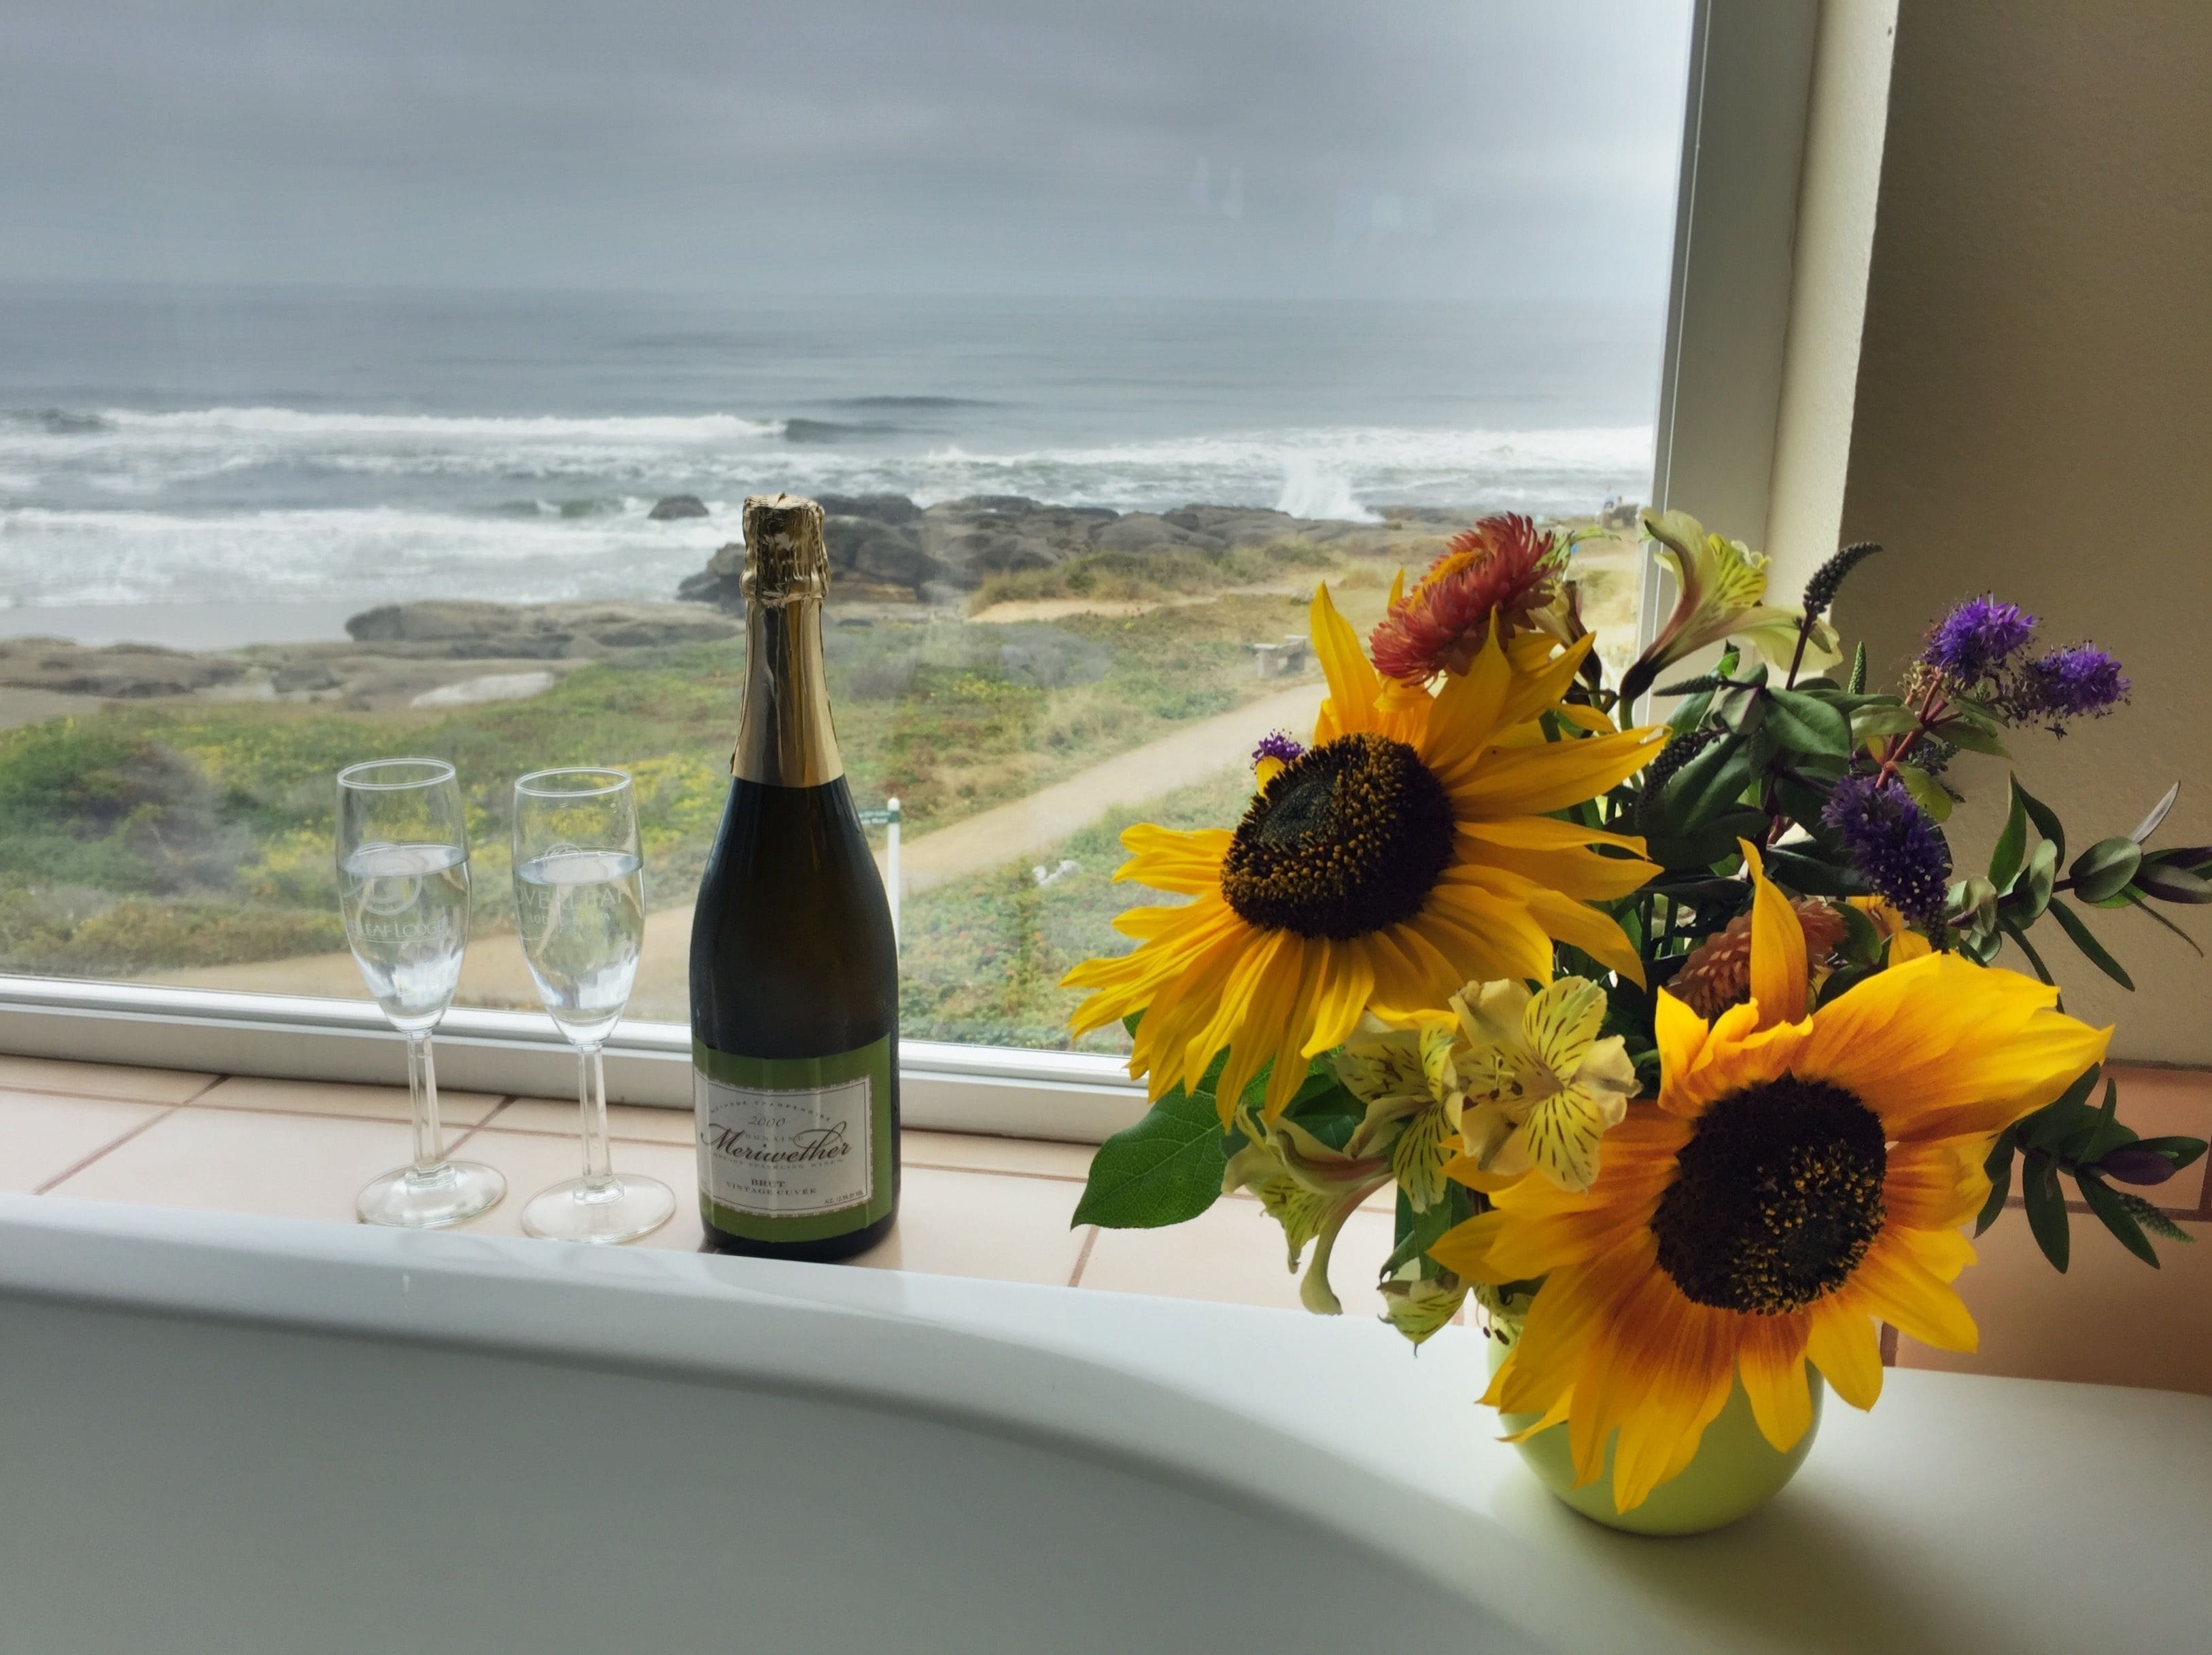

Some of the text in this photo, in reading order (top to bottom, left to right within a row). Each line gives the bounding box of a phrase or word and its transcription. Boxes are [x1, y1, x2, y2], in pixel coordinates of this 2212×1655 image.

[748, 1115, 786, 1128] 2000
[700, 1120, 850, 1163] Meriwether
[725, 1181, 773, 1196] VINTAGE
[750, 1178, 786, 1187] BRUT
